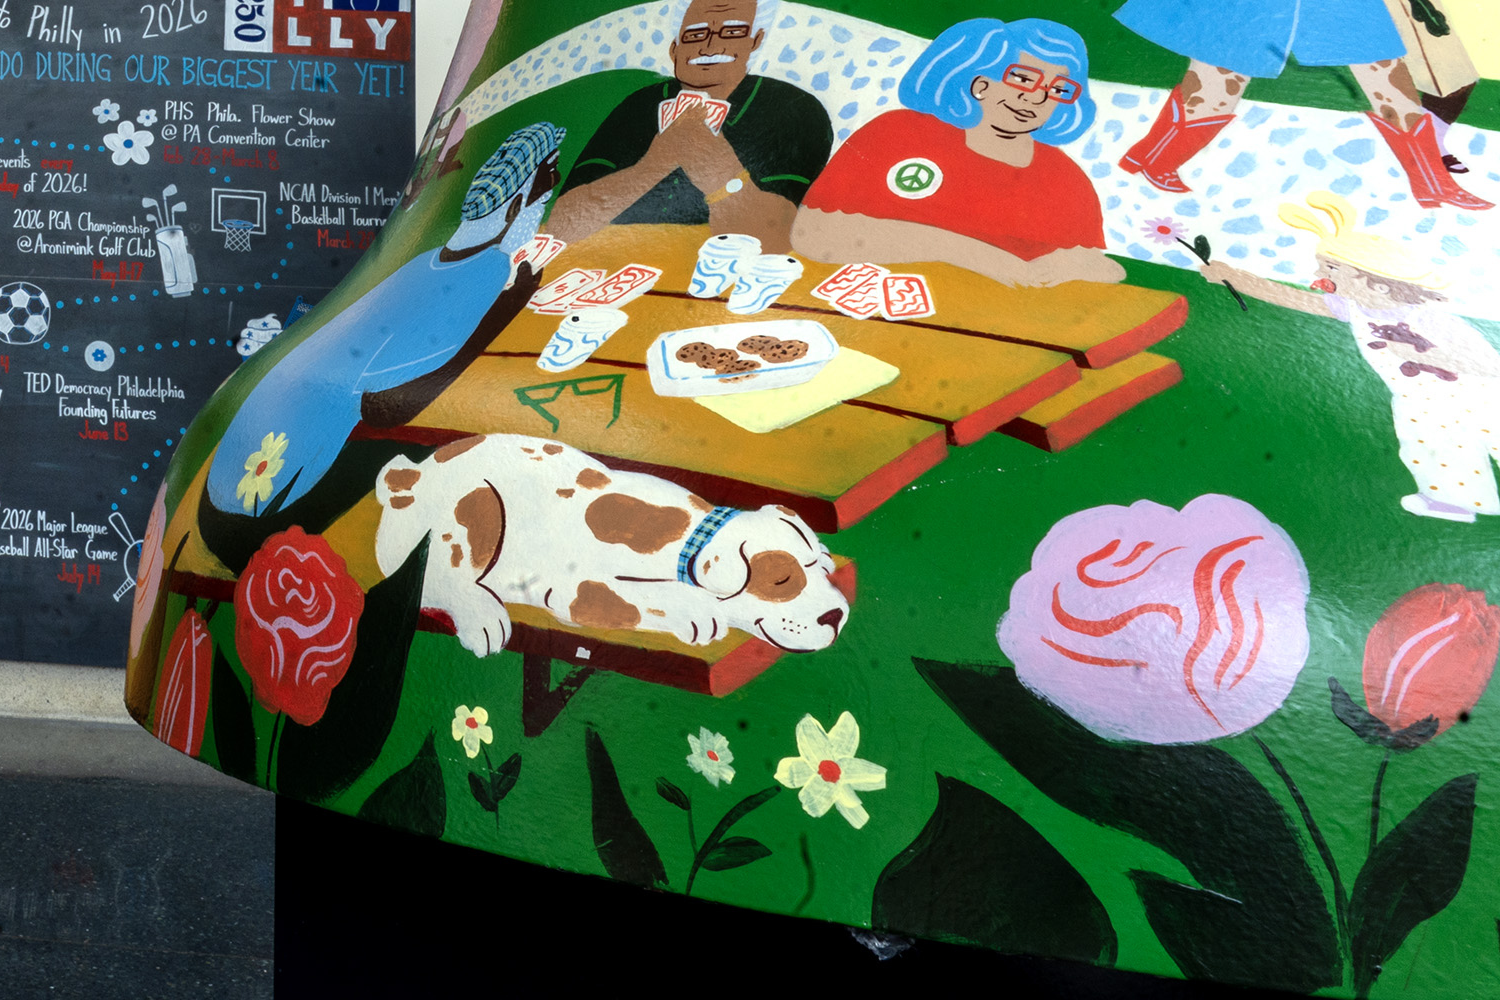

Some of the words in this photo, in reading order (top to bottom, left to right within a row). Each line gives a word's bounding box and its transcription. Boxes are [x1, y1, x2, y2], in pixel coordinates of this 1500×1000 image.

[27, 4, 83, 51] Philly
[102, 23, 121, 43] in
[0, 50, 23, 80] DO
[36, 51, 112, 83] DURING
[124, 54, 170, 87] OUR
[182, 56, 277, 91] BIGGEST
[287, 59, 339, 94] YEAR
[353, 61, 405, 98] YET!
[164, 100, 194, 121] PHS
[207, 101, 242, 123] Phila.
[252, 104, 293, 124] Flower
[298, 107, 336, 127] Show
[161, 124, 178, 141] @
[183, 124, 201, 143] PA
[208, 125, 276, 146] Convention
[285, 128, 330, 149] Center
[41, 158, 74, 174] every
[164, 145, 184, 165] Feb
[267, 150, 280, 171] 8
[23, 172, 38, 193] of
[41, 172, 88, 194] 2026!
[280, 181, 316, 203] NCAA
[321, 184, 361, 205] Division
[12, 208, 45, 229] 2026
[49, 210, 72, 231] PGA
[78, 212, 150, 239] Championship
[292, 204, 345, 226] Basketball
[99, 236, 125, 257] Golf
[126, 238, 156, 258] Club
[317, 228, 355, 249] March
[92, 260, 117, 289] May
[23, 371, 51, 393] TED
[55, 373, 112, 402] Democracy
[117, 375, 186, 403] Philadelphia
[58, 397, 108, 426] Founding
[111, 398, 157, 421] Futures
[78, 420, 109, 441] June
[114, 421, 129, 442] 13
[1, 508, 34, 531] 2026
[37, 510, 67, 538] Major
[71, 512, 108, 539] League
[34, 537, 78, 559] All-Star
[85, 539, 118, 562] Game
[57, 562, 84, 594] July
[87, 564, 101, 585] 14
